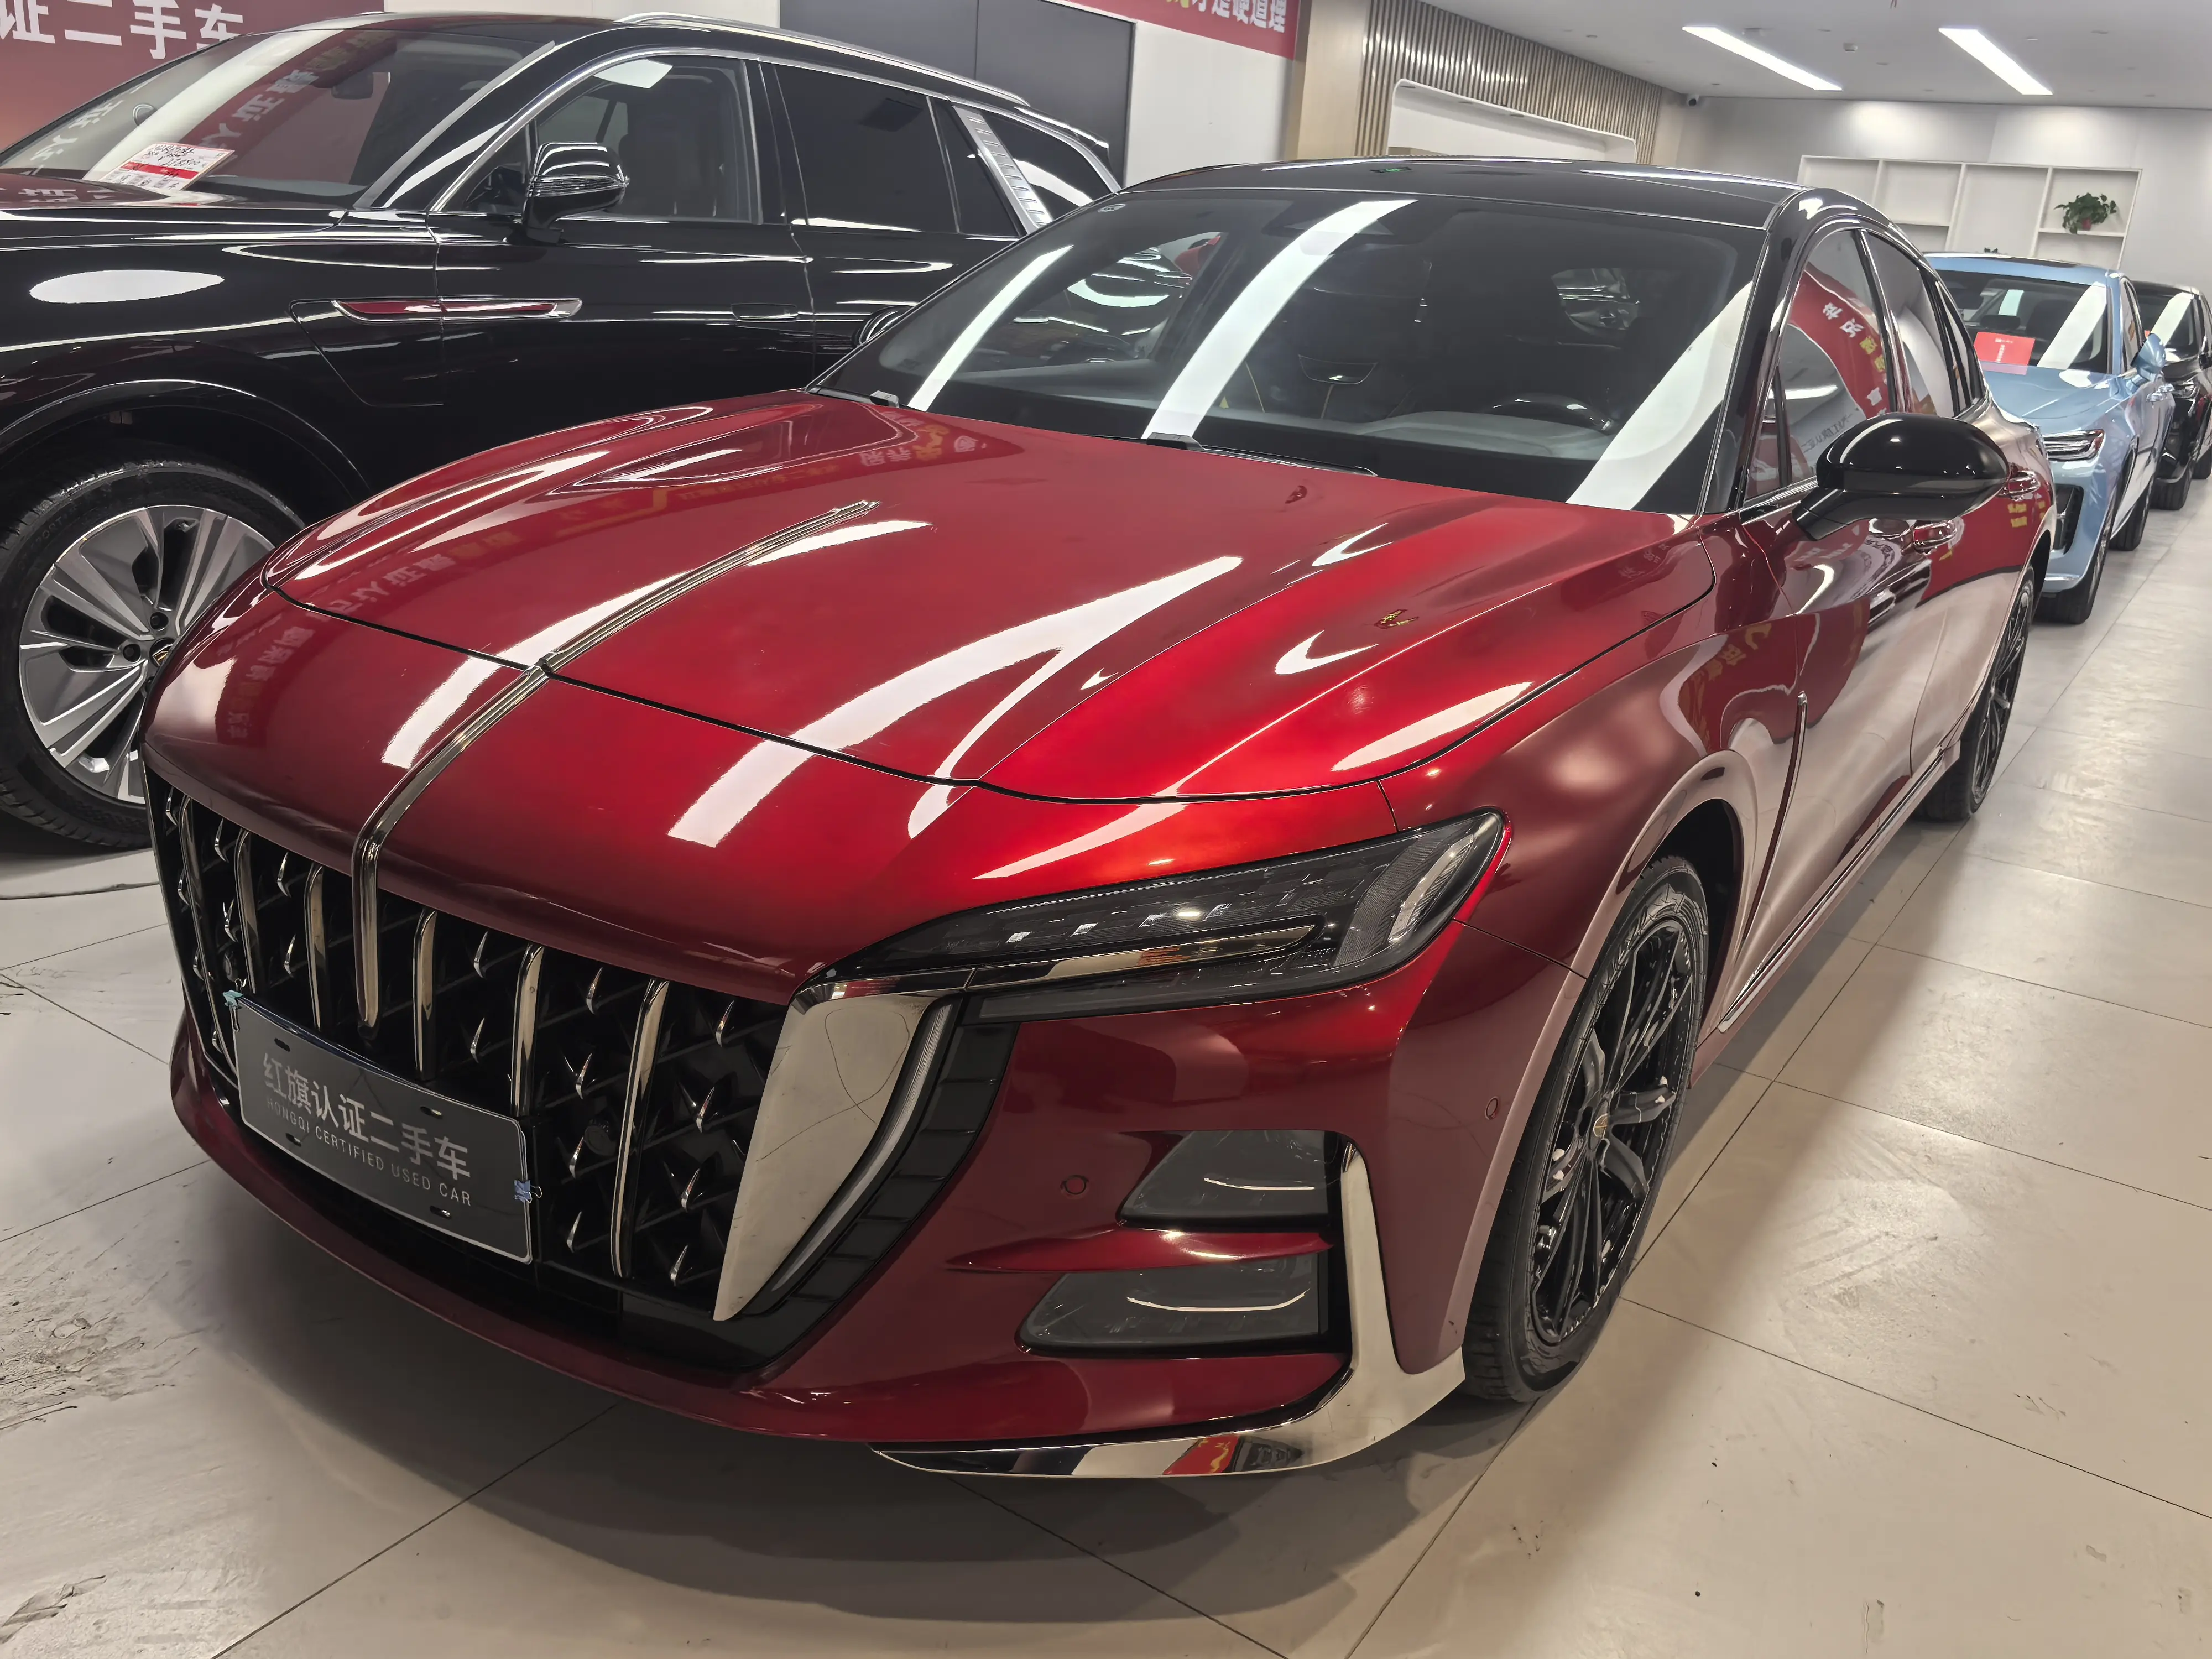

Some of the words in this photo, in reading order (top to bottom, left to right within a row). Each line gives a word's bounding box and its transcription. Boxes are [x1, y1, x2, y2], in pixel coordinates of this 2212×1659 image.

[263, 1051, 470, 1180] 红旗认证二手车
[266, 1099, 310, 1133] HONGQI
[315, 1126, 384, 1171] CERTIFIED
[391, 1164, 431, 1190] USED
[439, 1183, 472, 1206] CAR
